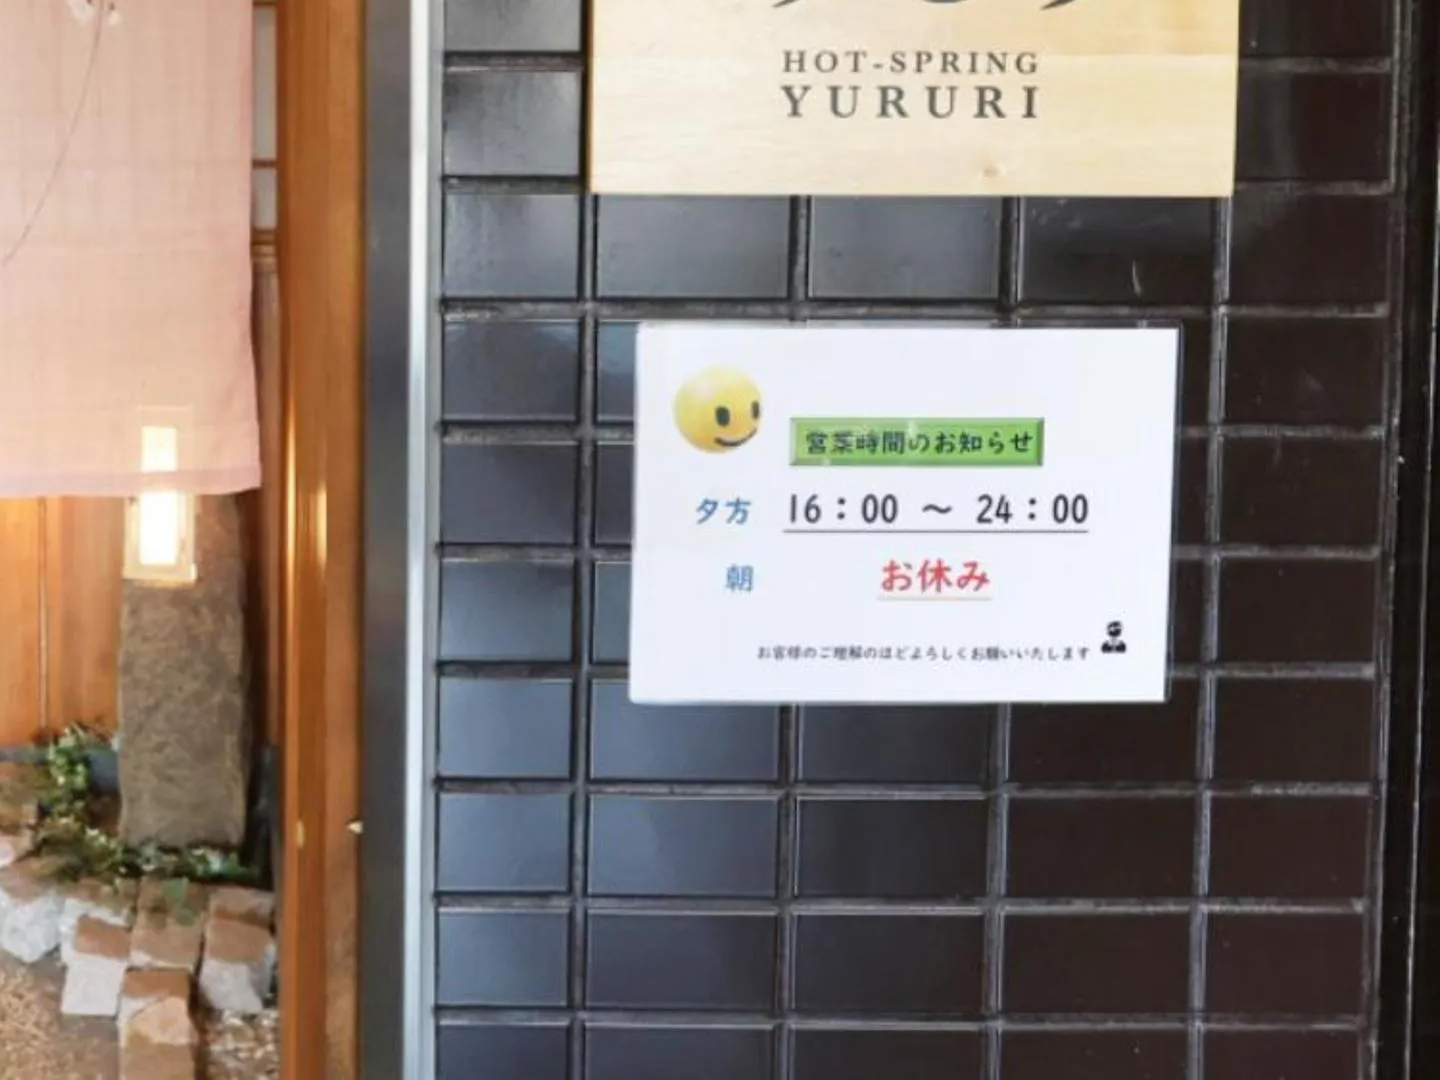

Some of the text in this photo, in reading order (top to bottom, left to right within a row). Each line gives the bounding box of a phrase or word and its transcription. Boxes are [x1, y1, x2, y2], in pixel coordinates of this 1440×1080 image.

[782, 49, 1039, 75] HOT-SPRING
[782, 84, 1039, 120] YURURI
[805, 429, 1033, 457] 営業時間のお知らせ
[695, 496, 752, 526] 夕方
[724, 564, 755, 592] 朝
[880, 558, 990, 593] お休み
